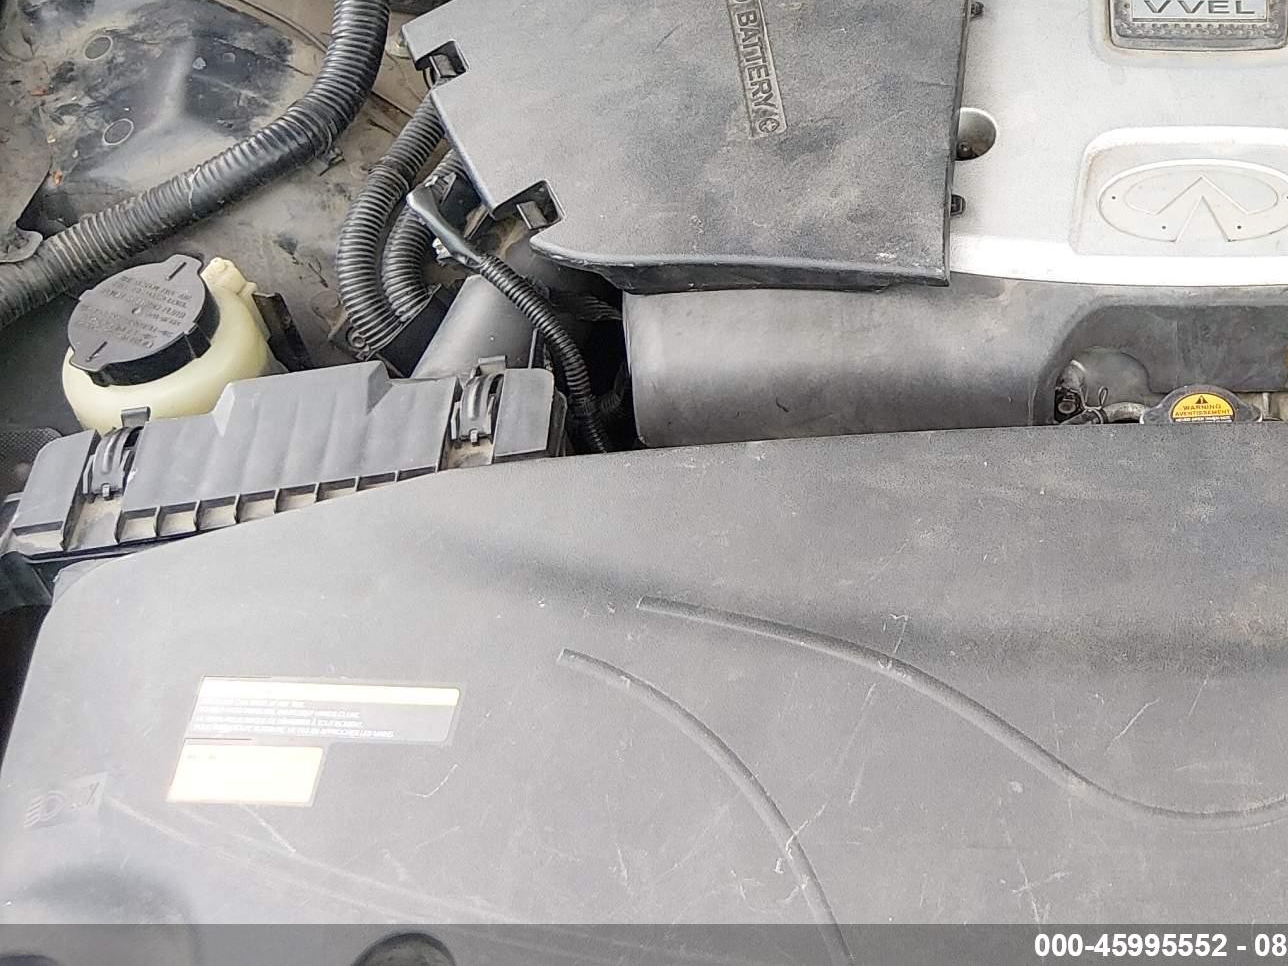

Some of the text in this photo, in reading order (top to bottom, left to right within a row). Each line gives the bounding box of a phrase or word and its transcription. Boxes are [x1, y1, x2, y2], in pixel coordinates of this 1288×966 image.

[1143, 0, 1256, 15] VVEL
[736, 9, 779, 109] BATTERY
[1182, 403, 1222, 412] WARNING
